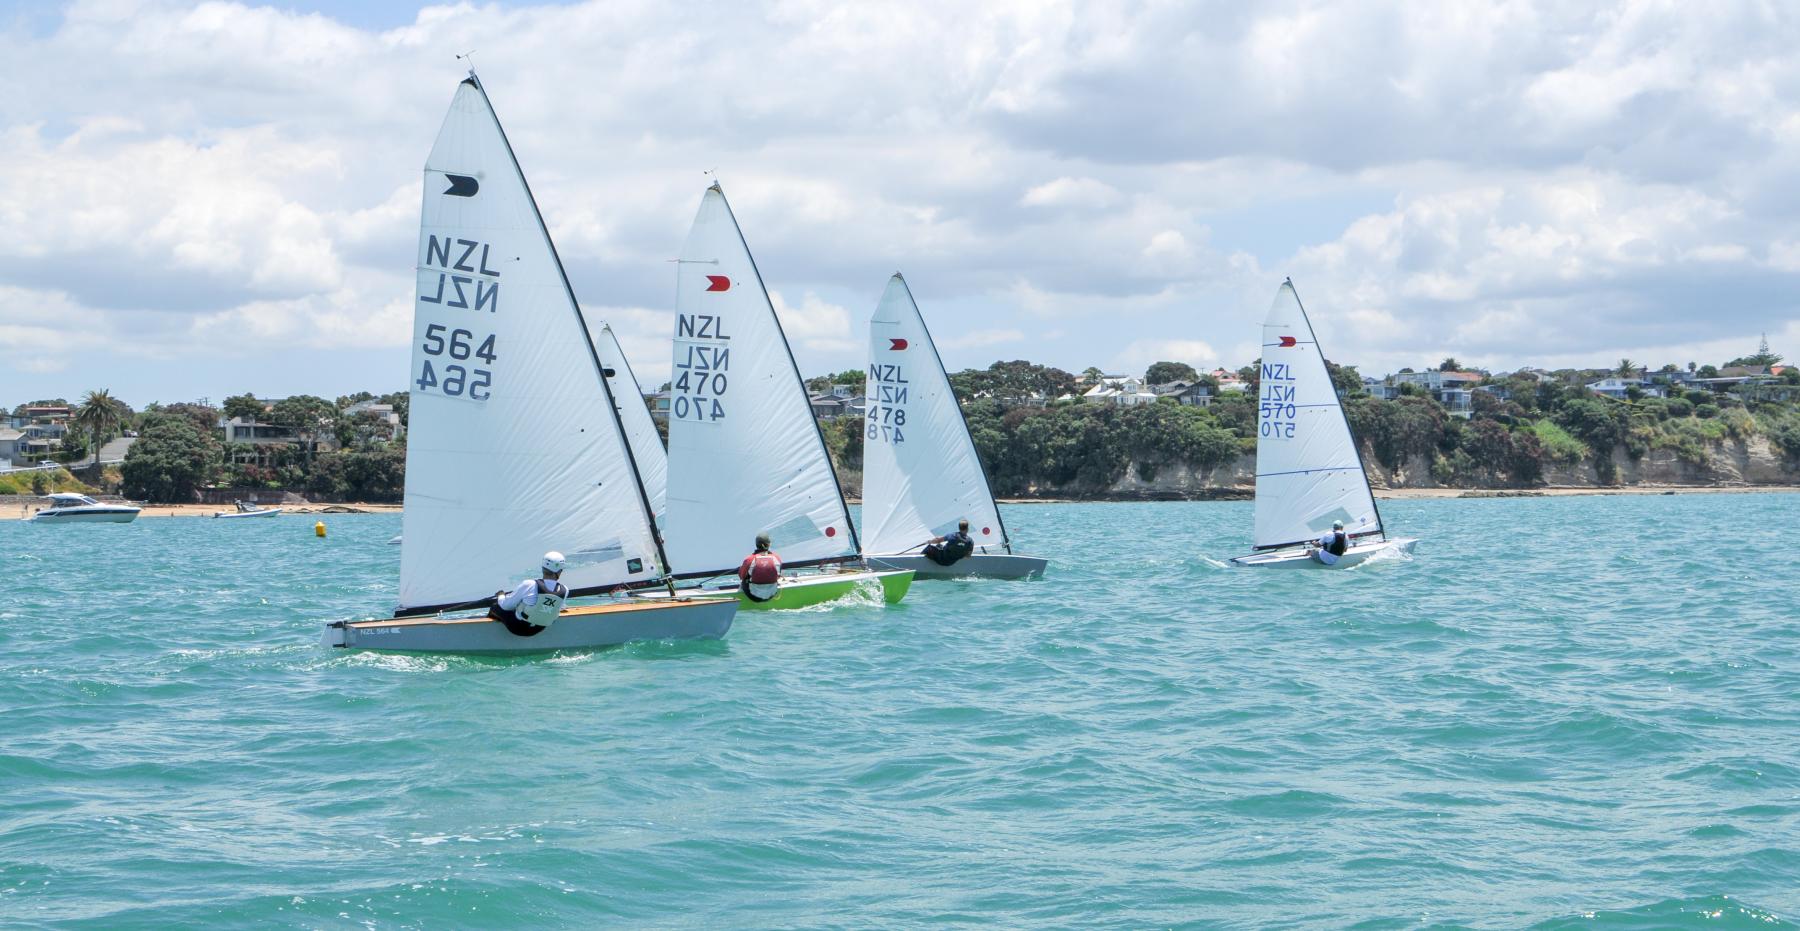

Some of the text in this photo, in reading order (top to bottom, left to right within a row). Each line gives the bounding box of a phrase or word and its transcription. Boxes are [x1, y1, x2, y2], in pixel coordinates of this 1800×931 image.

[426, 234, 500, 277] NZL
[679, 313, 731, 340] NZL
[423, 323, 497, 365] 564
[870, 363, 908, 384] NZL
[1262, 363, 1296, 381] NZL
[676, 370, 727, 396] 470
[868, 405, 906, 426] 478
[1262, 402, 1296, 419] 570
[543, 597, 556, 607] ZK
